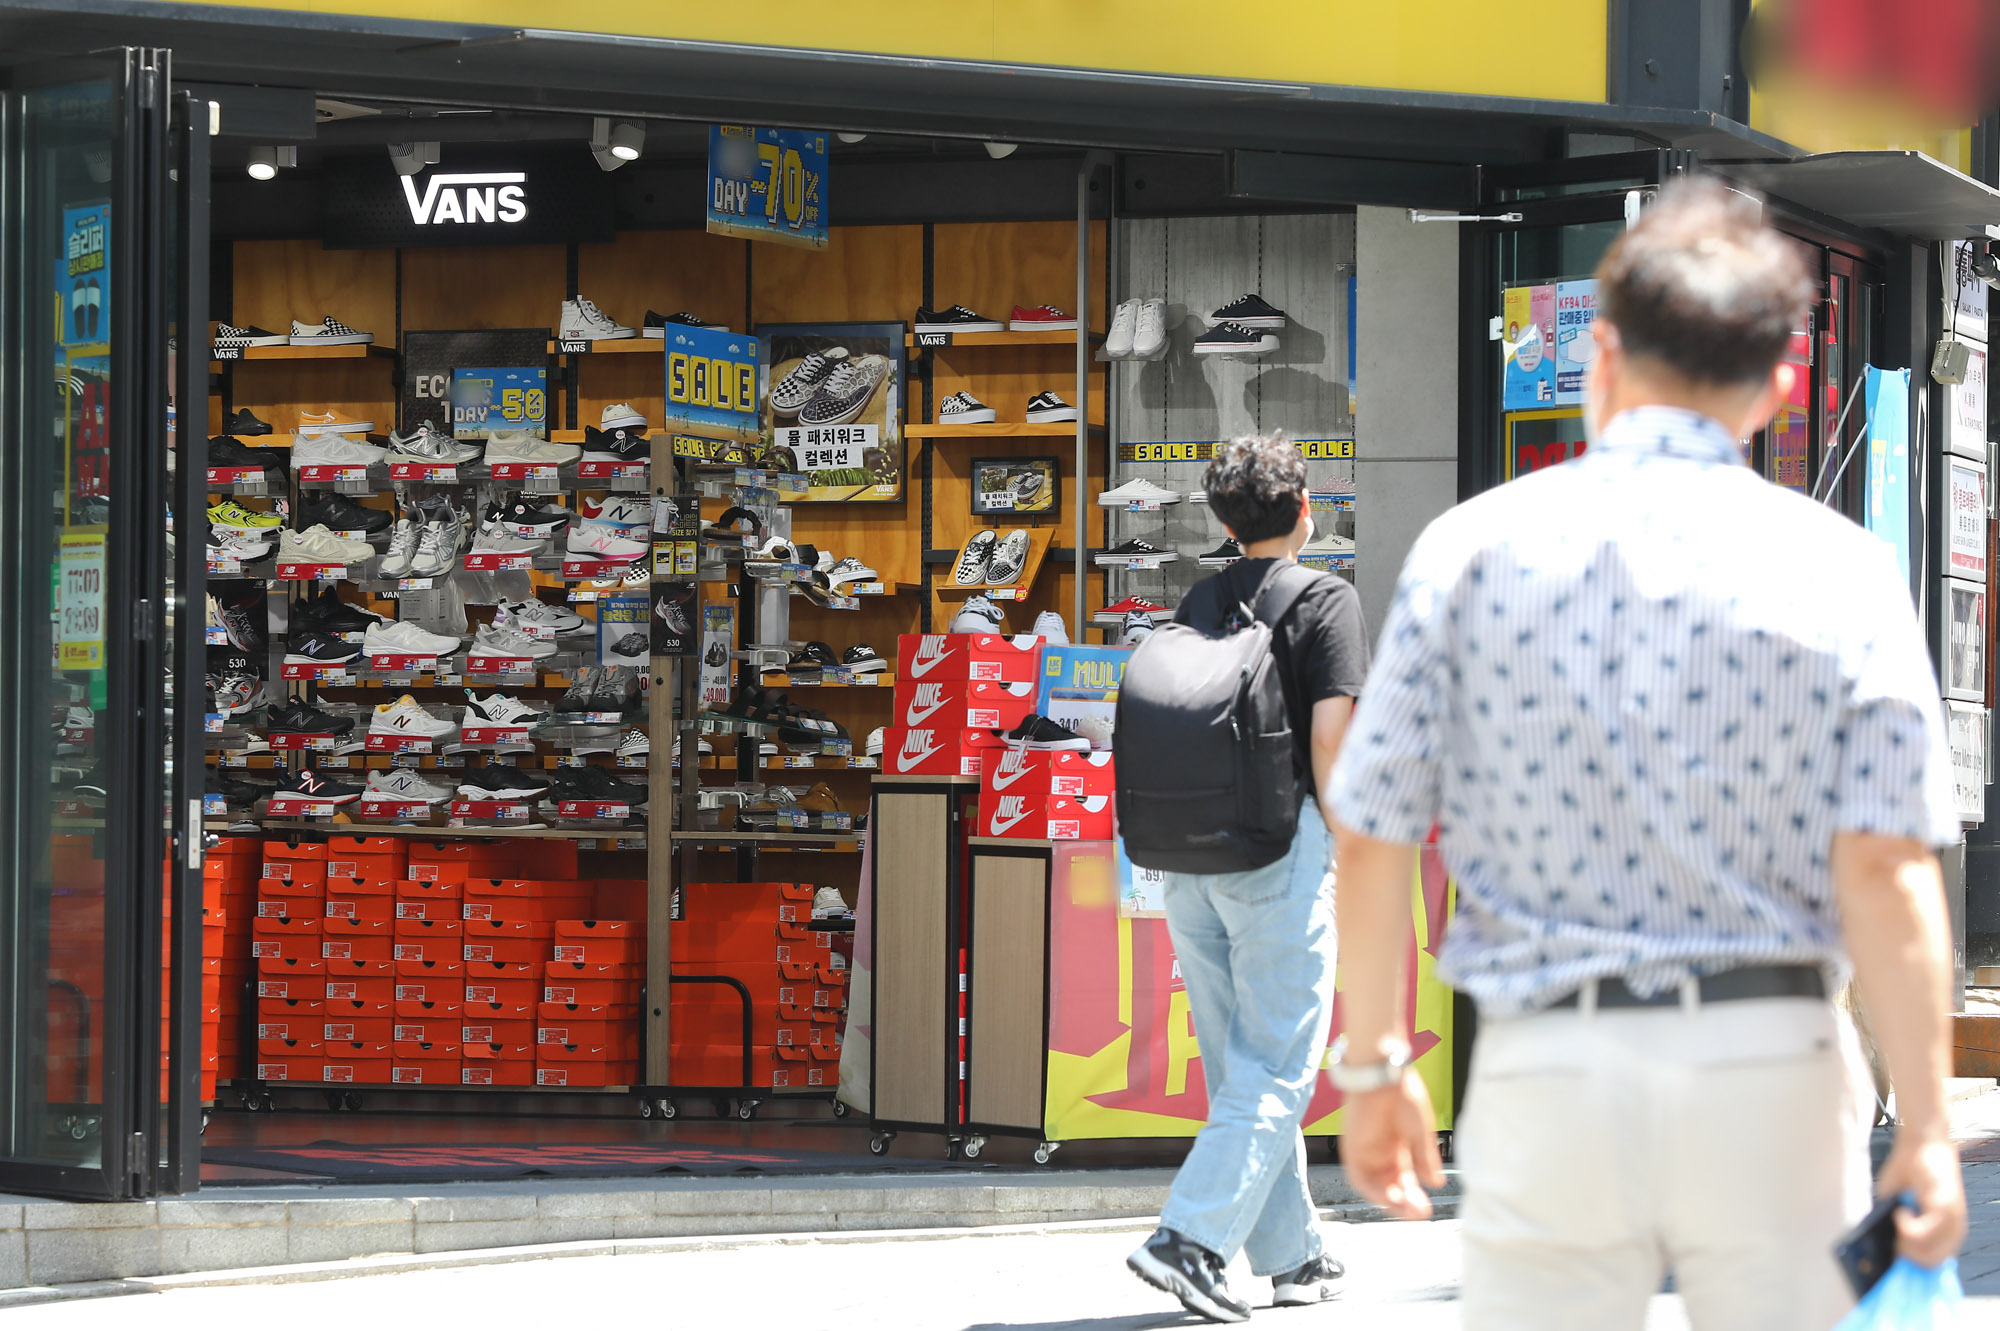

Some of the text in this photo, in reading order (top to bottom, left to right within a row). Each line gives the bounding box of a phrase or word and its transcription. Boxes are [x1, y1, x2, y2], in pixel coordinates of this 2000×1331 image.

[400, 172, 528, 225] VANS
[714, 177, 751, 216] DAY
[68, 225, 104, 260] 슬리퍼
[1559, 296, 1580, 309] KF94
[560, 341, 586, 353] VANS
[920, 334, 946, 345] VANS
[213, 348, 239, 359] VANS
[672, 357, 752, 408] SALE
[455, 406, 488, 423] DAY
[788, 428, 867, 446] 뮬 패치워크
[675, 438, 704, 457] SALE
[1137, 445, 1194, 459] SALE
[805, 449, 849, 467] 컬렉션
[875, 484, 893, 493] VANS
[671, 529, 685, 537] SIZE
[381, 591, 400, 599] VAN
[603, 609, 634, 623] 놀라운
[666, 639, 680, 647] 530
[918, 634, 948, 659] NIKE
[228, 658, 246, 668] 530
[913, 683, 944, 707] NIKE
[903, 729, 936, 753] NIKE
[996, 795, 1027, 818] NIKE
